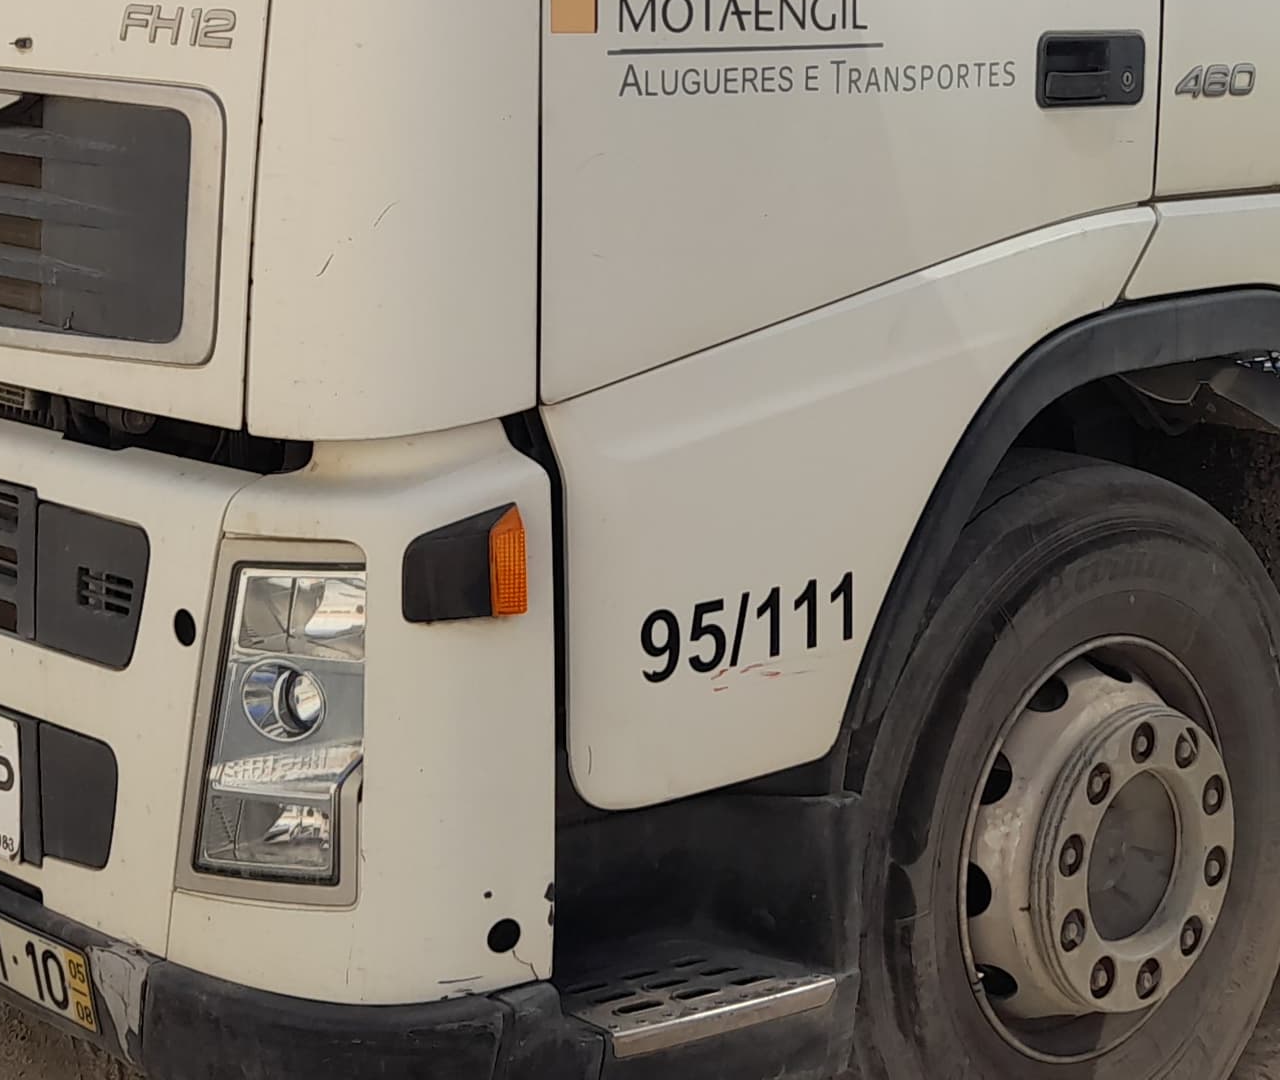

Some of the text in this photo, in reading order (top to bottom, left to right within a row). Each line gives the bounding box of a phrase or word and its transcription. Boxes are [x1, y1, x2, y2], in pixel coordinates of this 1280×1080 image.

[618, 59, 1017, 97] ALUGUERES E TRANSPORTES
[1174, 62, 1256, 99] 460
[640, 571, 853, 683] 95/111
[67, 958, 87, 985] 05
[75, 1000, 94, 1026] 08
